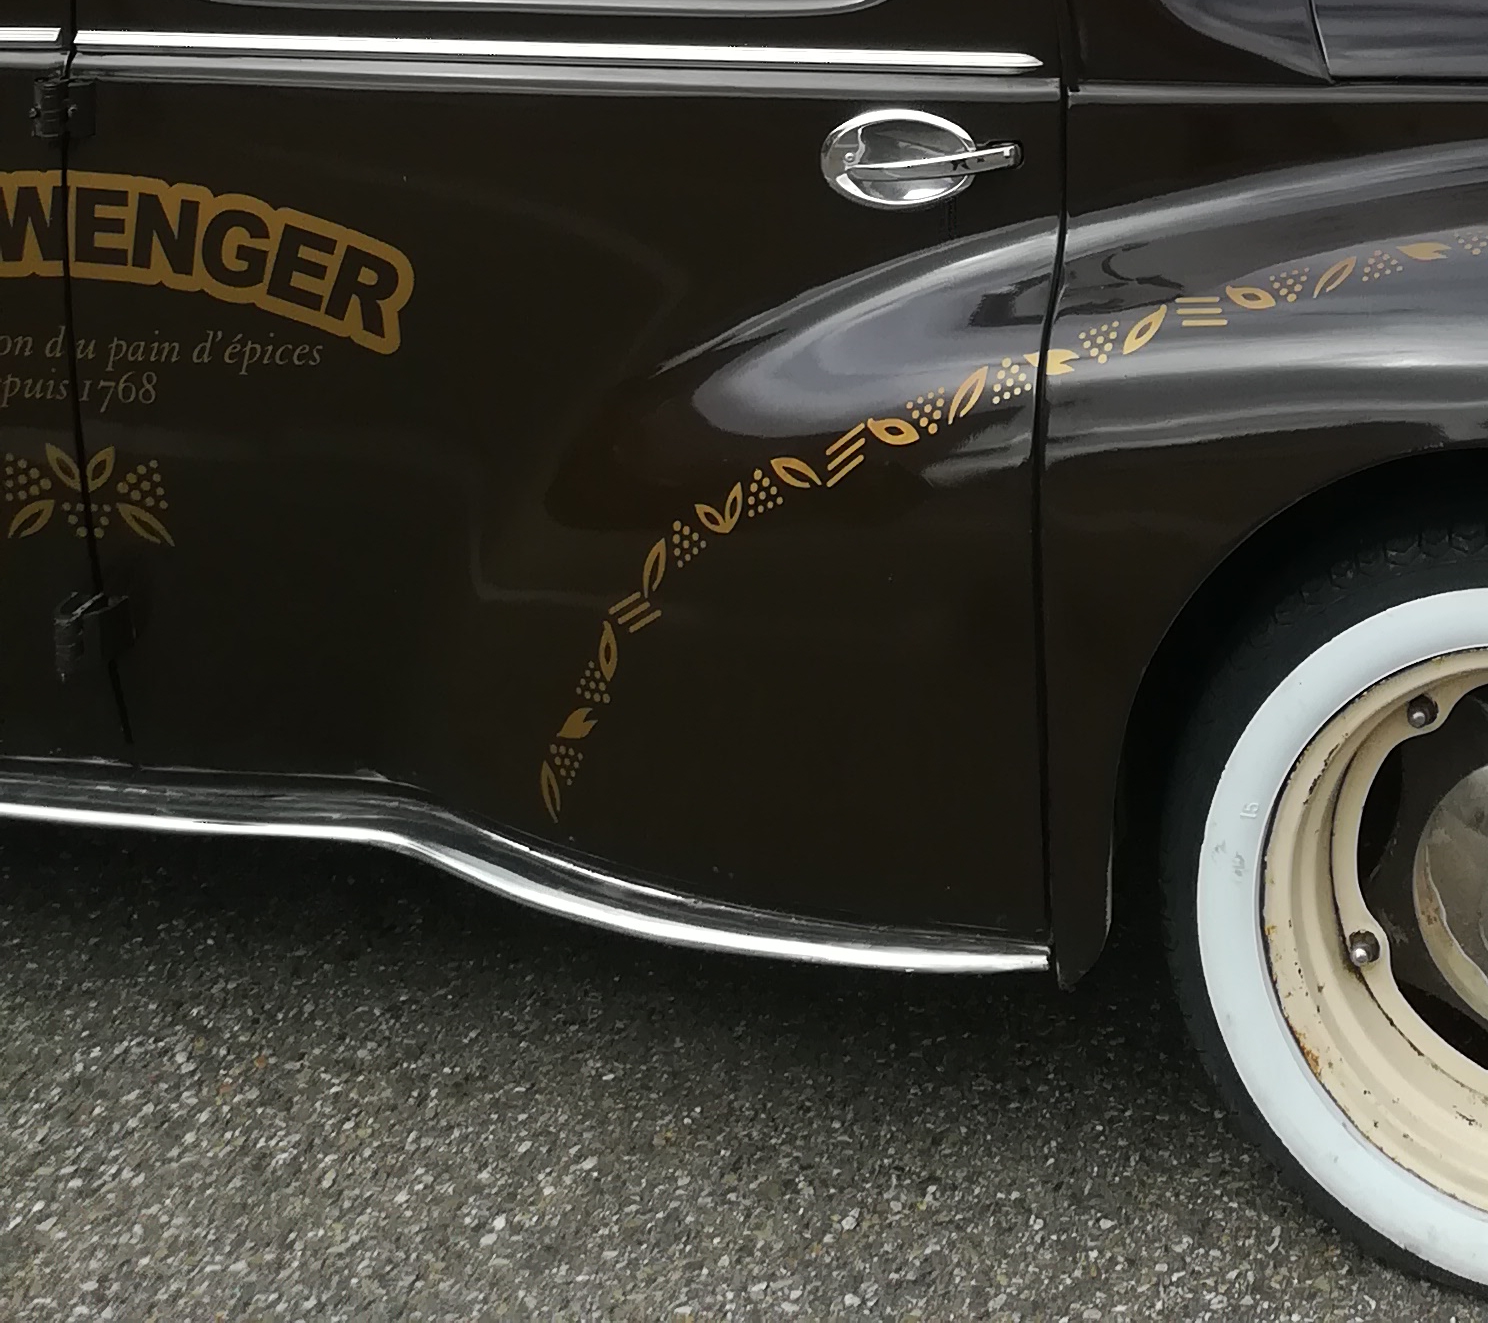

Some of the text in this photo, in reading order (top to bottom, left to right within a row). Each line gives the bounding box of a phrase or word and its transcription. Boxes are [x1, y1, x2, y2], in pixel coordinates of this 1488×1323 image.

[0, 181, 406, 343] WENGER
[44, 325, 97, 359] du
[106, 329, 181, 372] pain
[191, 329, 325, 376] d'épices
[78, 370, 159, 414] 1768
